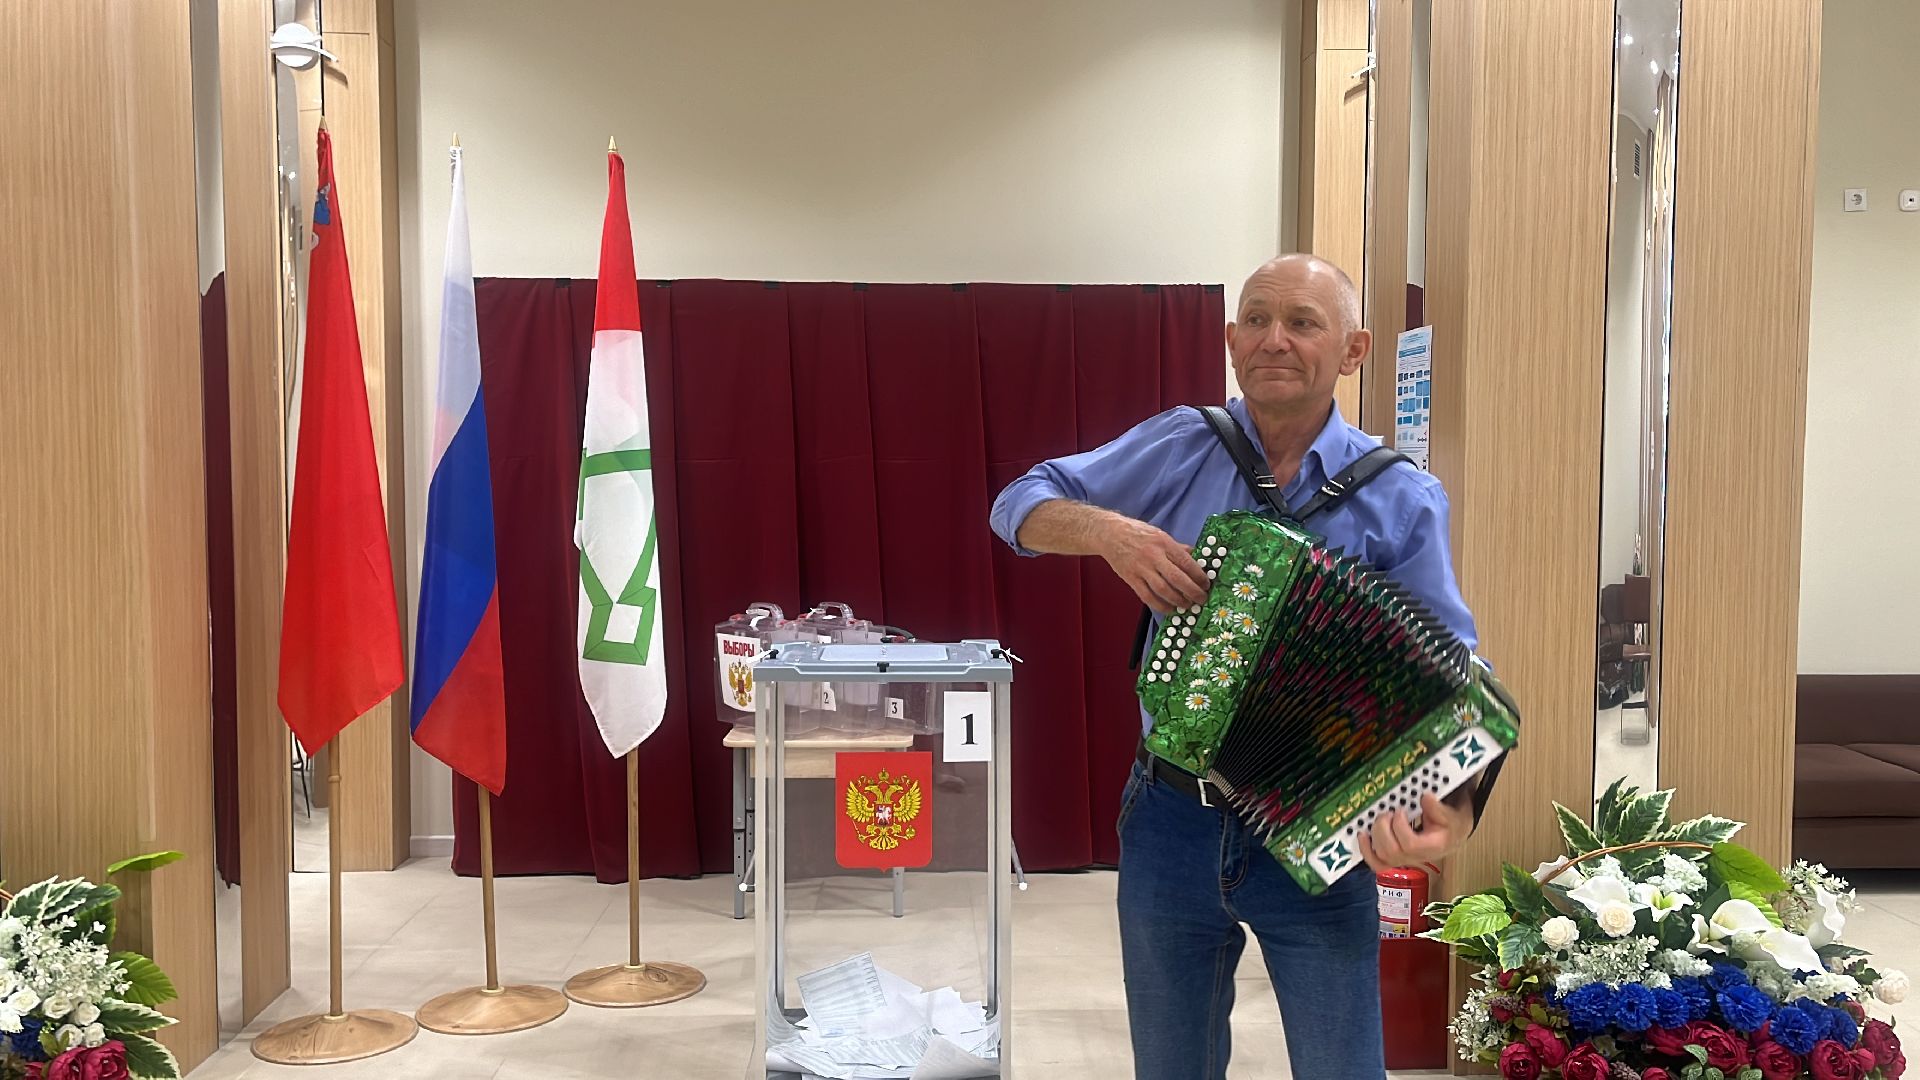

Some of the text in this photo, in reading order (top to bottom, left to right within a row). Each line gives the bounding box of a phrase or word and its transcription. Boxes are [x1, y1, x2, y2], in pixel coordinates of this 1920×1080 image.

[723, 639, 755, 658] ВЫБОРЫ
[823, 691, 830, 704] 2
[891, 701, 898, 714] 3
[960, 713, 979, 746] 1
